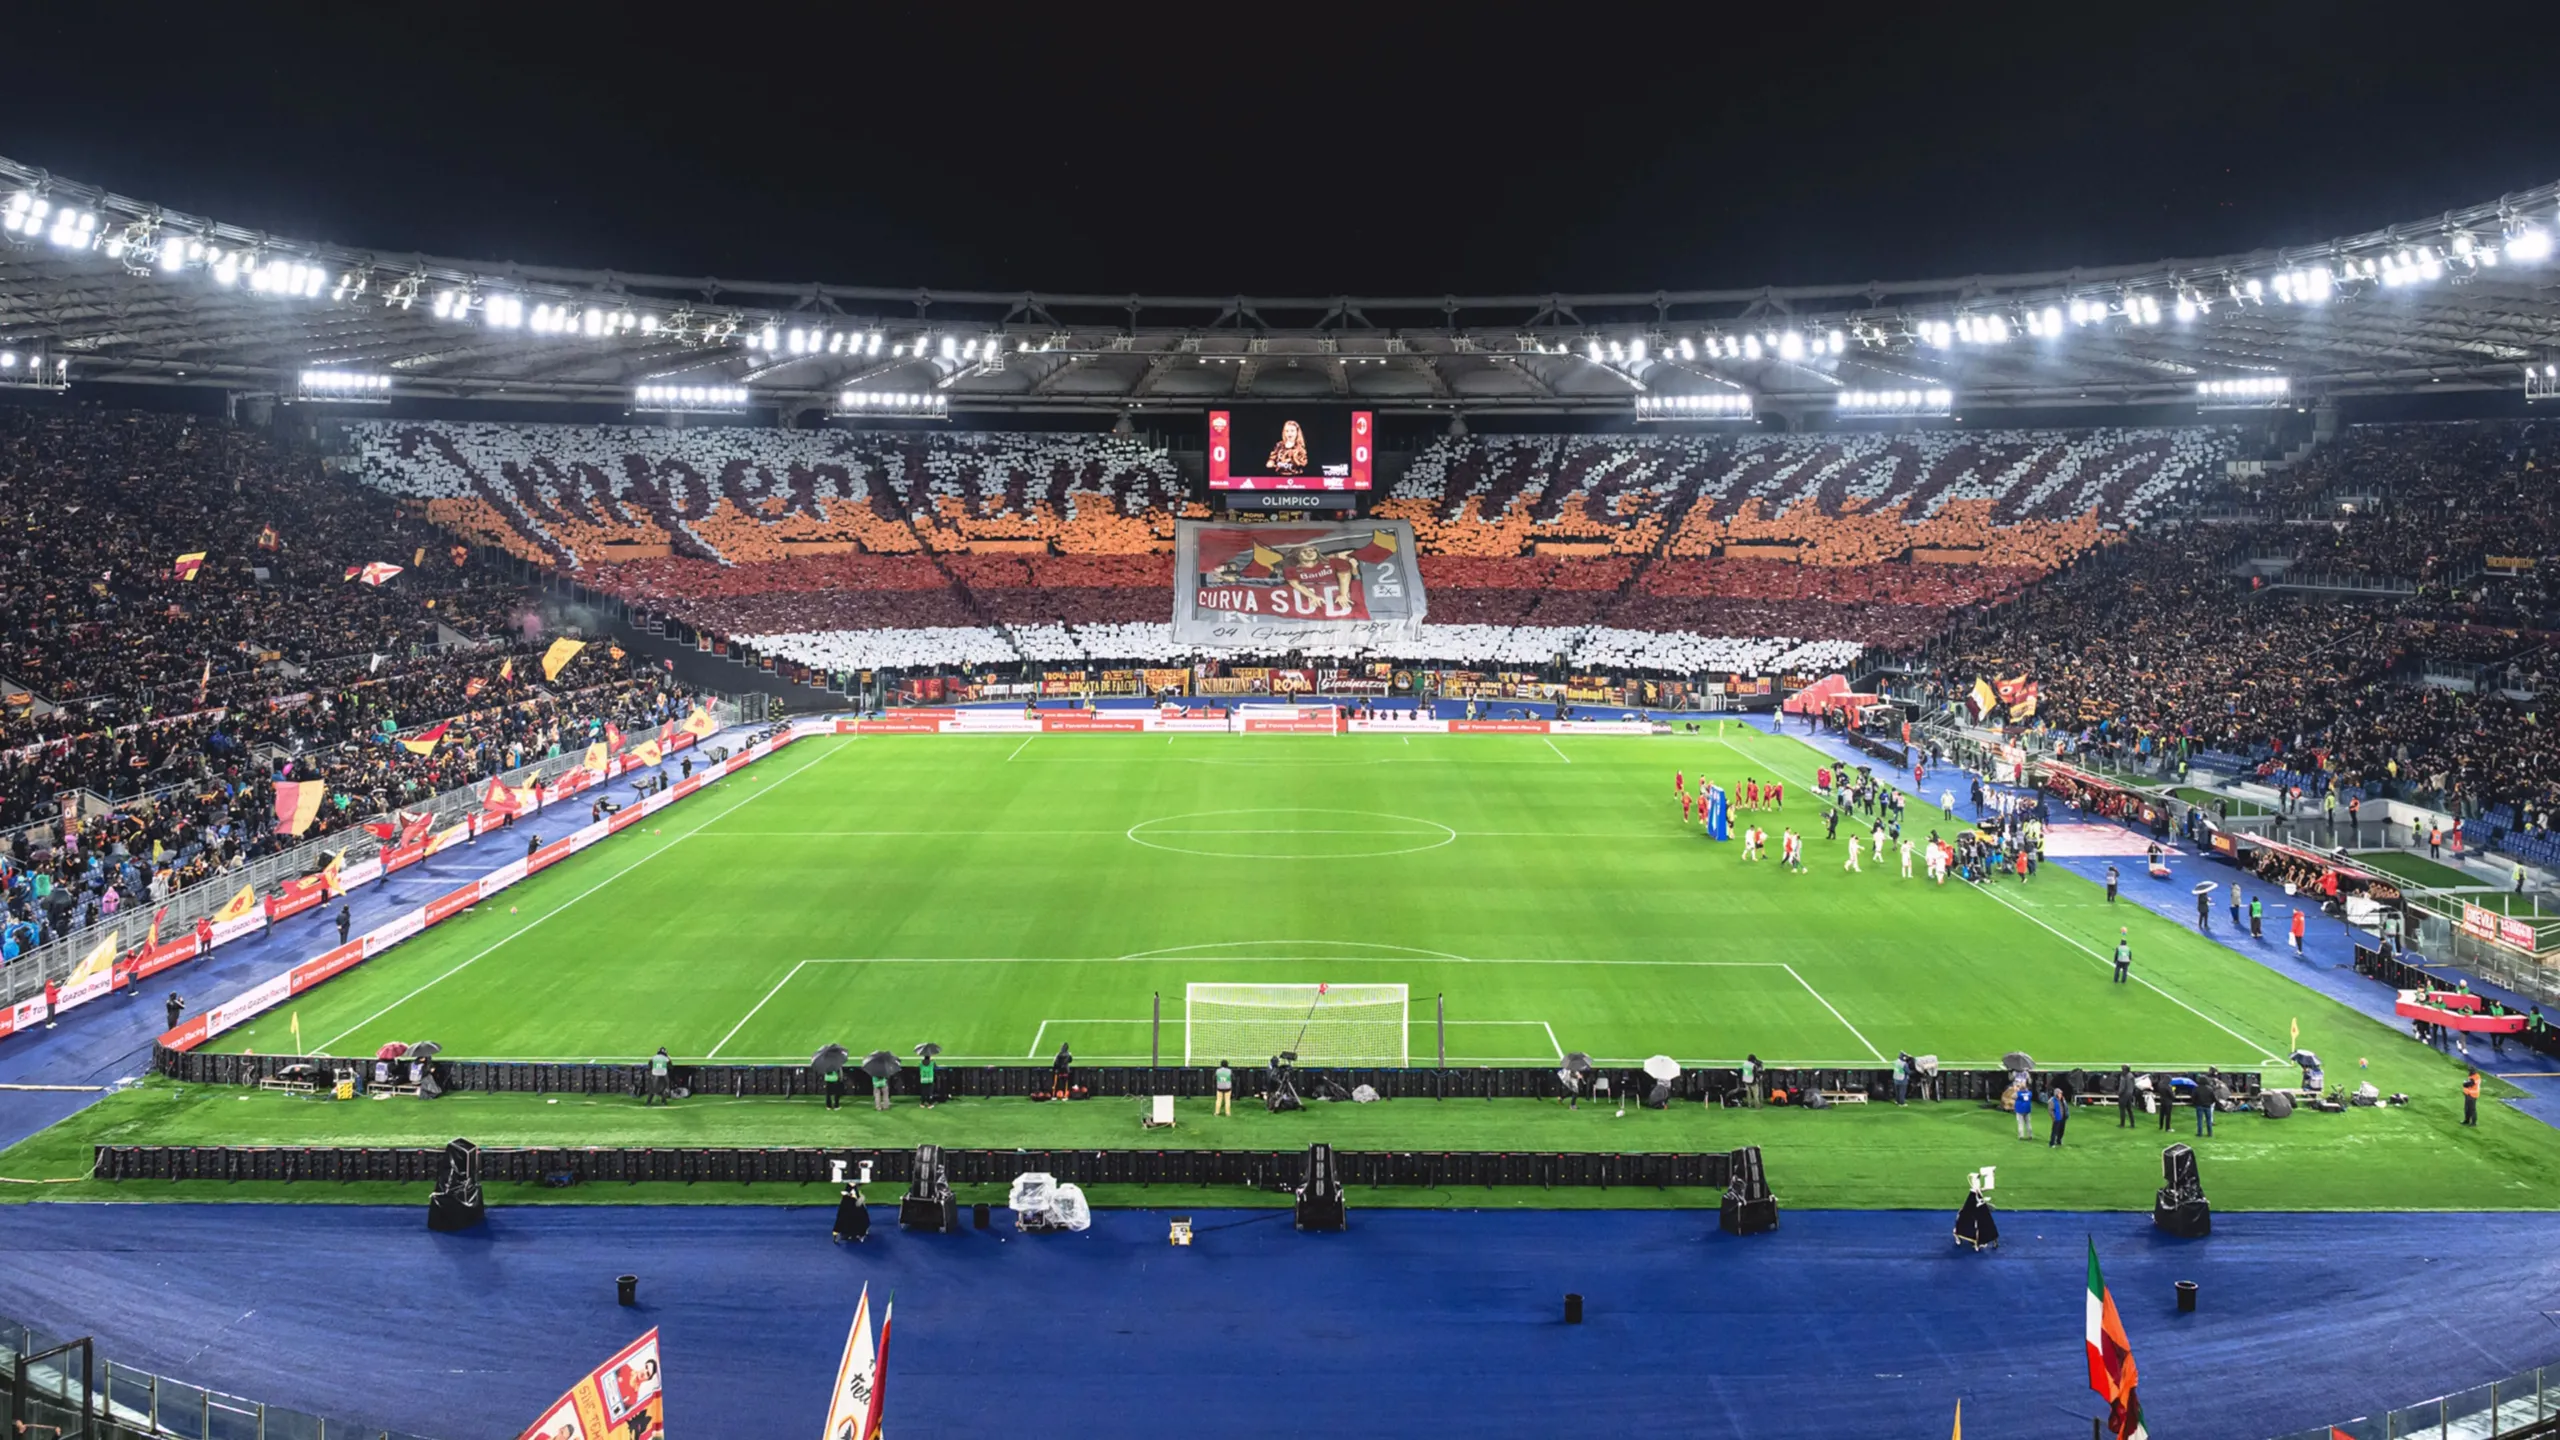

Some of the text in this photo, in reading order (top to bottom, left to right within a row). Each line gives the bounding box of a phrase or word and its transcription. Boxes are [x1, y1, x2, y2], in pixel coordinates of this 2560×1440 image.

[1213, 446, 1226, 462] 0
[1355, 446, 1368, 462] 0
[1262, 496, 1320, 506] OLIMPICO
[1299, 568, 1334, 580] Barilla
[1376, 562, 1398, 584] 2
[1198, 590, 1258, 612] CURVA
[1270, 585, 1353, 617] SUD
[1904, 662, 1912, 673] A
[1069, 681, 1100, 693] BRIGATA
[1101, 680, 1111, 692] DE
[1273, 679, 1313, 691] ROMA
[62, 988, 87, 1003] GAZOO
[88, 979, 111, 993] Racing
[185, 1025, 206, 1042] Racing
